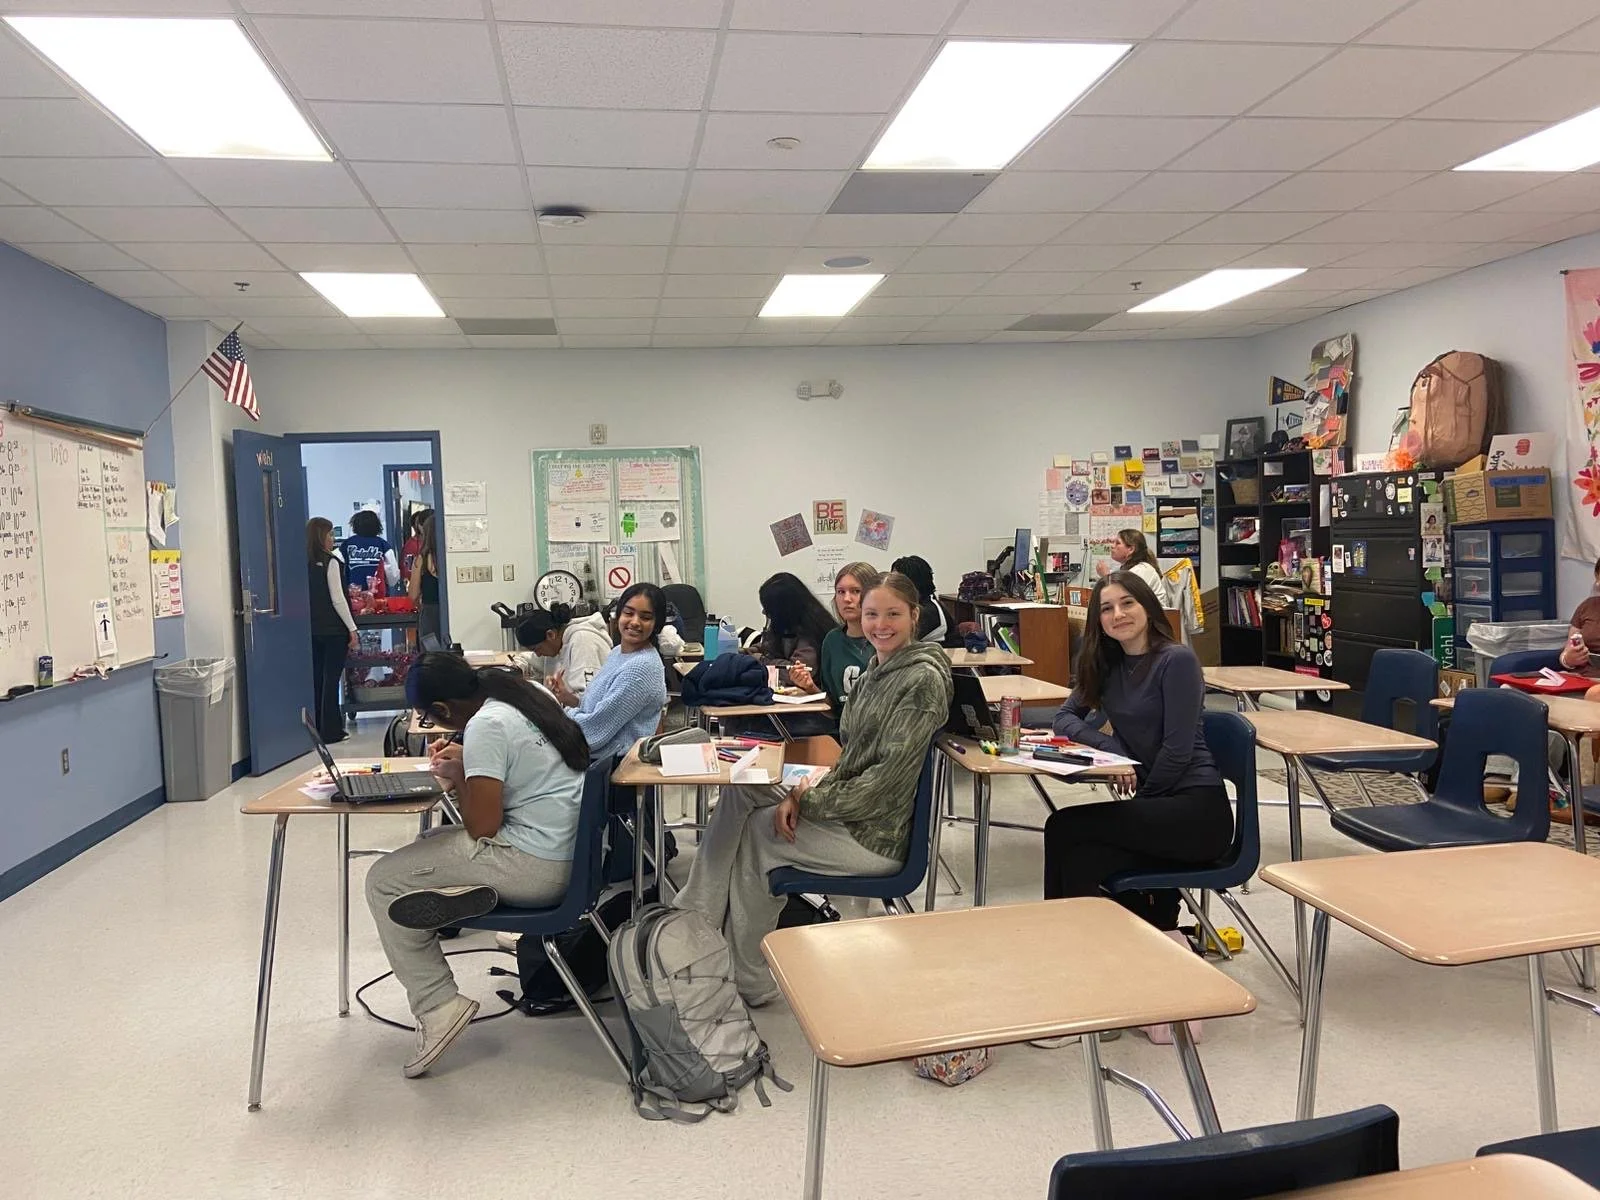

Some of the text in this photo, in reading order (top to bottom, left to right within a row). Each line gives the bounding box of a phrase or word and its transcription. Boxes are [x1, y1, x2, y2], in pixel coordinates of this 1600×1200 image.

[816, 502, 843, 518] BE
[817, 519, 844, 532] HAPPY
[603, 546, 617, 555] NO
[554, 575, 562, 583] 12
[1440, 634, 1454, 670] Viehl
